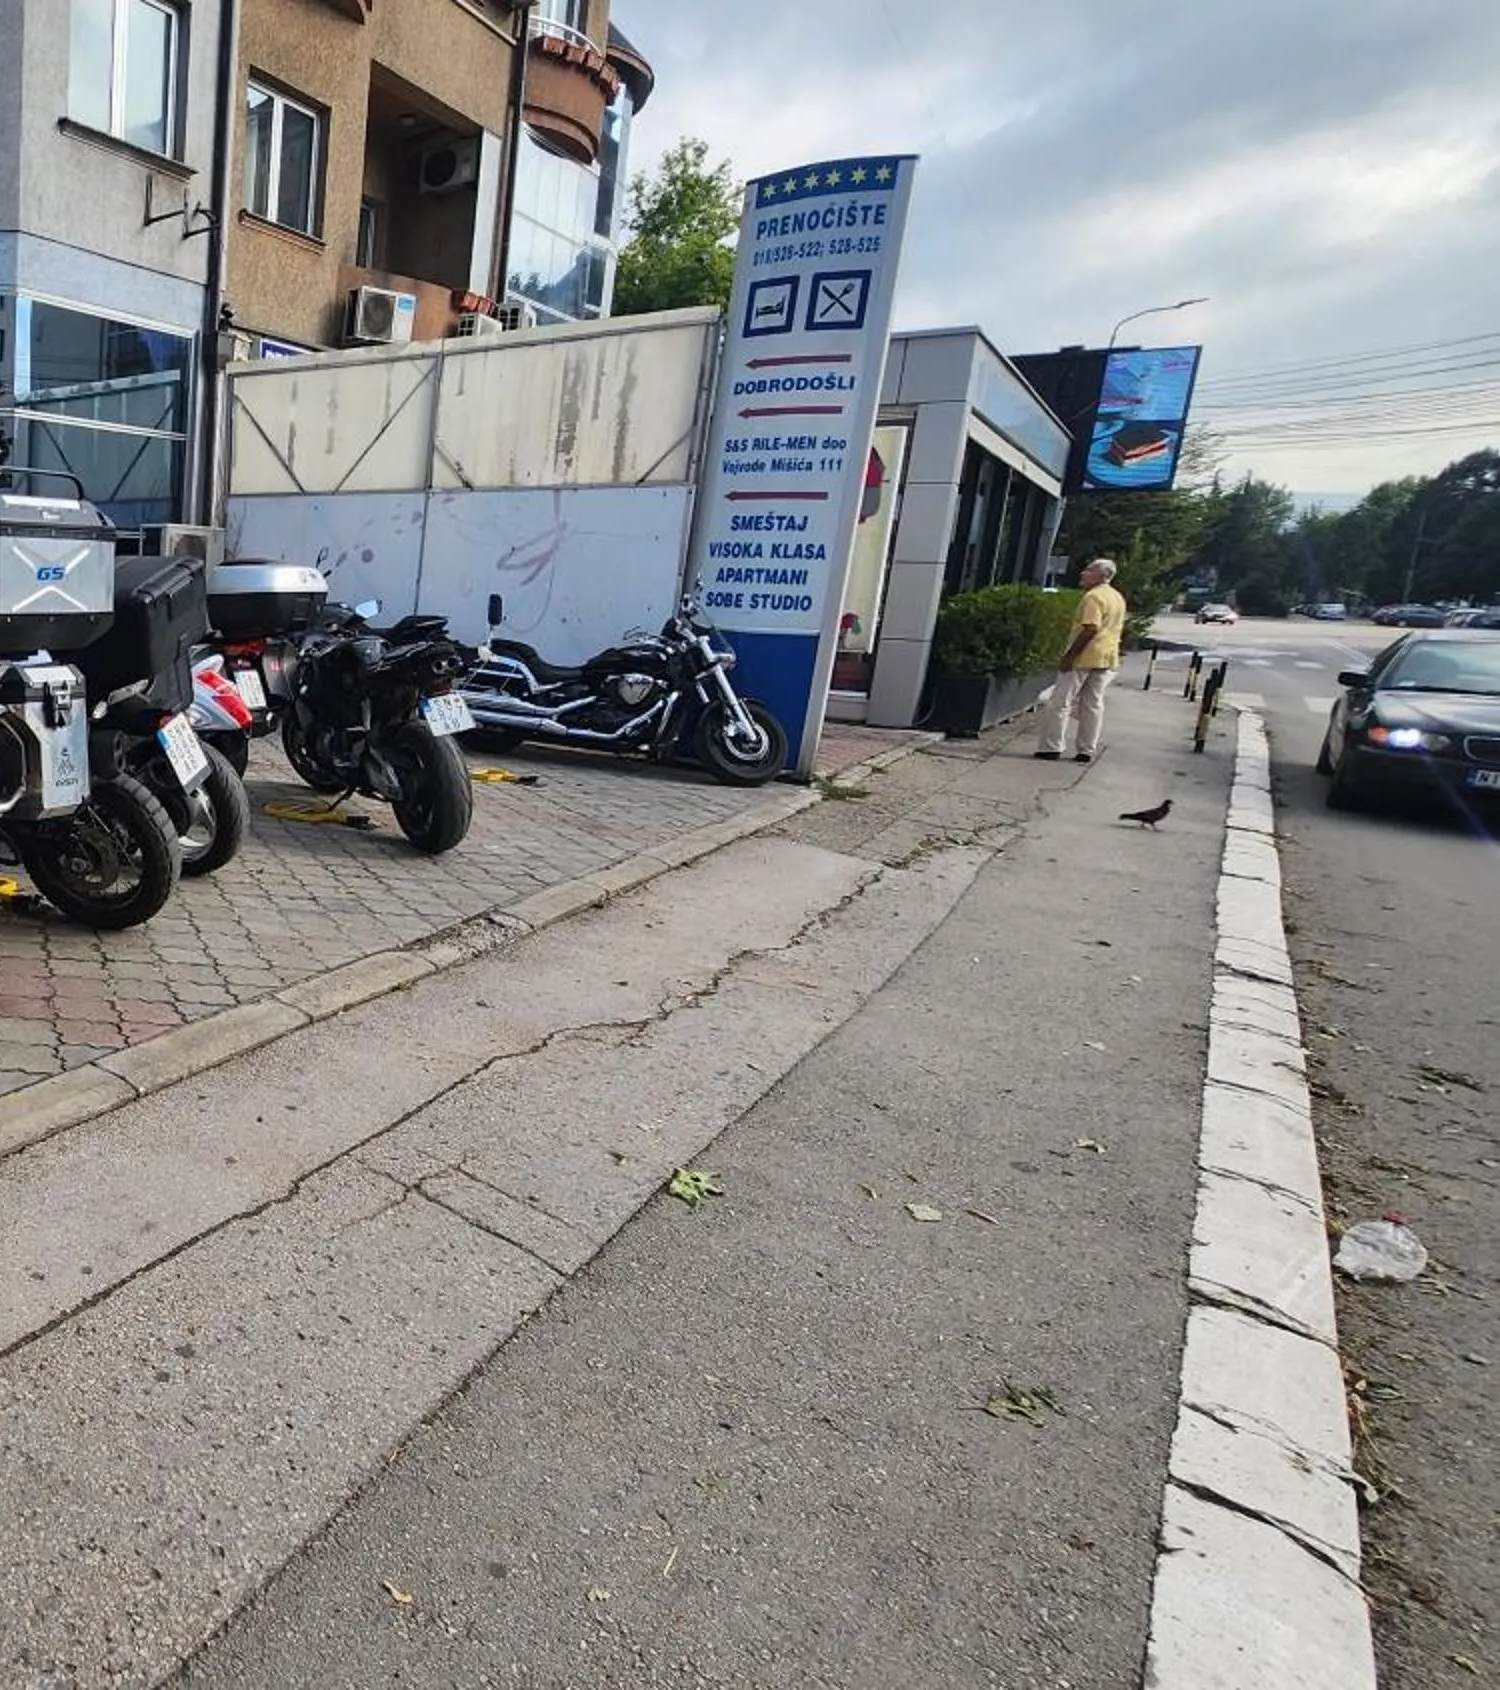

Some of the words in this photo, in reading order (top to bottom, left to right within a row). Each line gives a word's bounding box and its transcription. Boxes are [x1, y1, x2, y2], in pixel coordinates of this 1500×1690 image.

[733, 375, 855, 395] DOBRODOŠLI
[822, 436, 847, 450] doo
[730, 511, 809, 531] SMEŠTAJ
[709, 541, 763, 559] VISOKA
[770, 543, 826, 560] KLASA
[36, 567, 66, 581] GS
[716, 567, 808, 585] APARTMANI
[706, 591, 744, 608] SOBE
[749, 593, 812, 611] STUDIO
